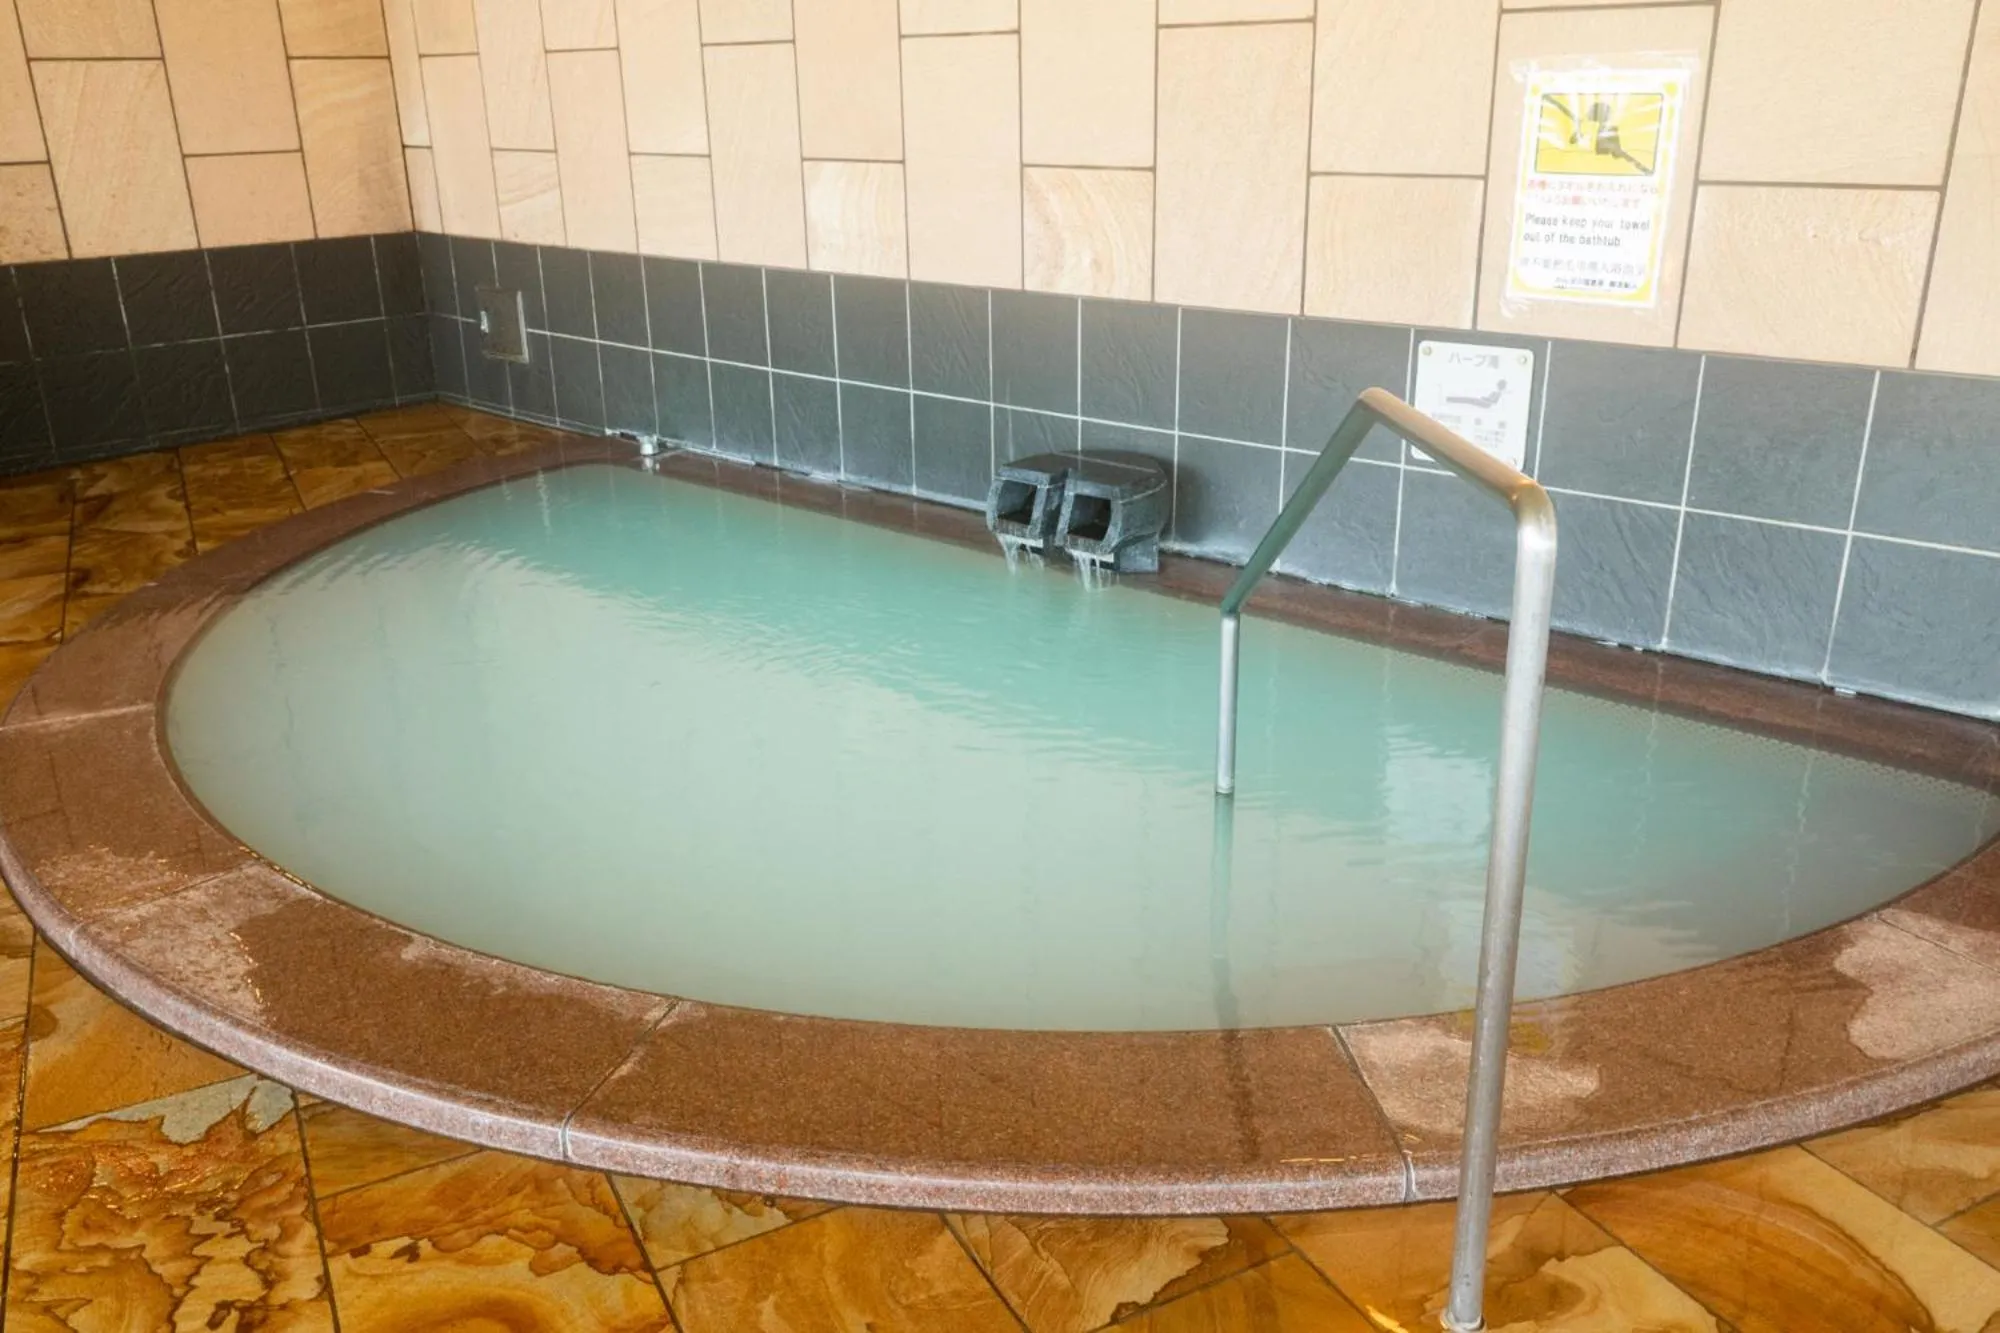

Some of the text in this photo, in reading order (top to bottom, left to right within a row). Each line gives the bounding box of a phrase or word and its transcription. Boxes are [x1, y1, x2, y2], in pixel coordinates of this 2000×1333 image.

[1525, 212, 1558, 226] Please
[1562, 215, 1587, 229] keep
[1620, 218, 1650, 231] towel
[1523, 232, 1621, 247] out of the bathtub
